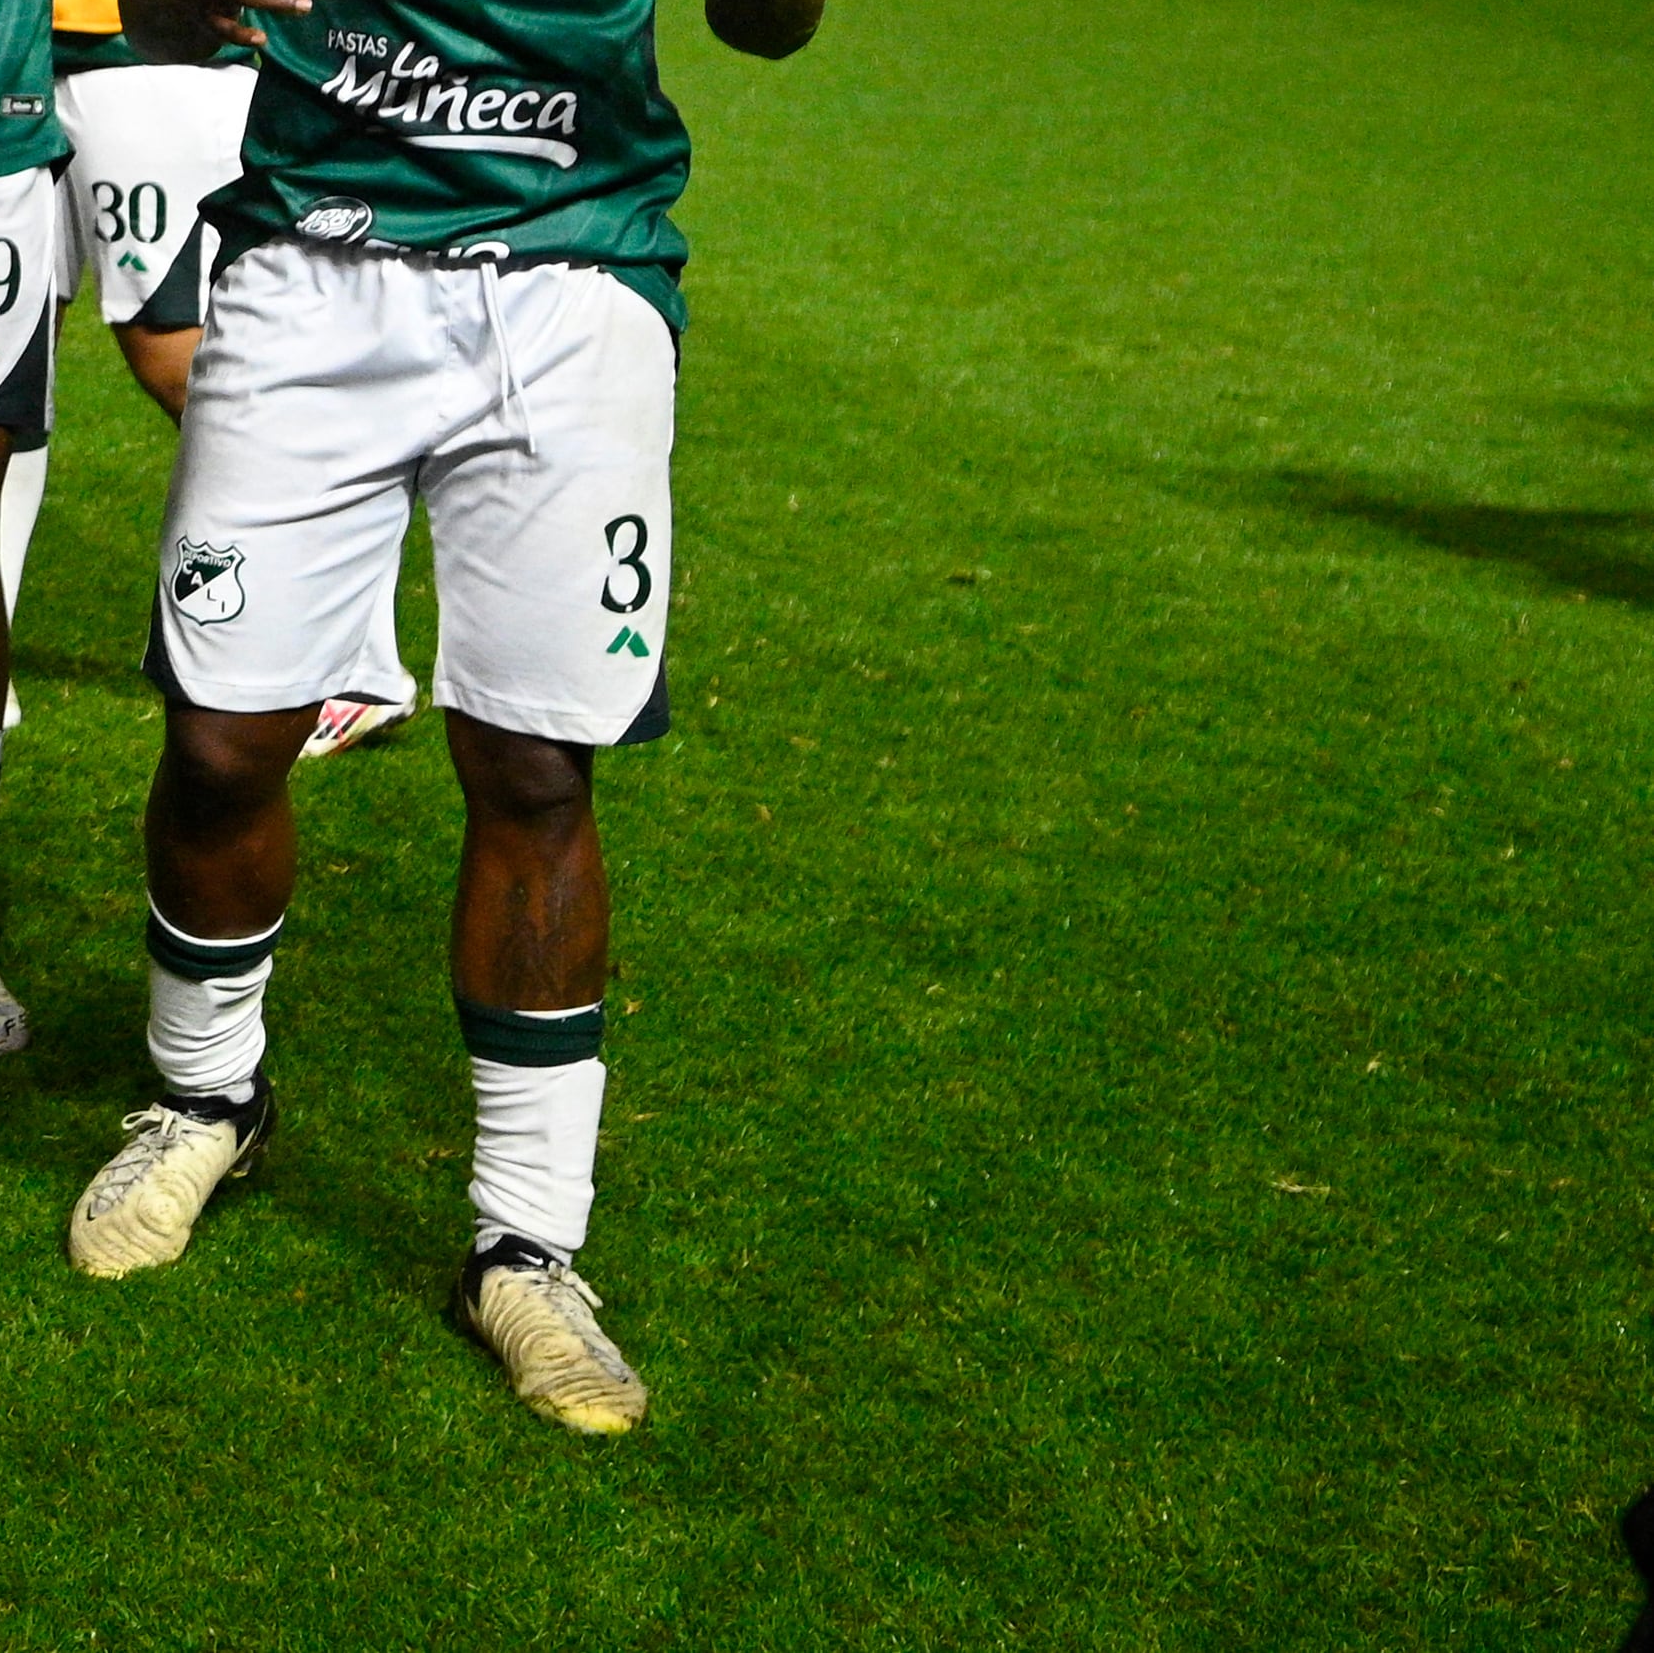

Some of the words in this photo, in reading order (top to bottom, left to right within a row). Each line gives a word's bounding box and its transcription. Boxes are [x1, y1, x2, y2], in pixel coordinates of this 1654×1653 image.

[328, 29, 389, 59] PASTAS
[392, 42, 440, 80] La
[92, 181, 167, 243] 30
[601, 513, 652, 615] 3
